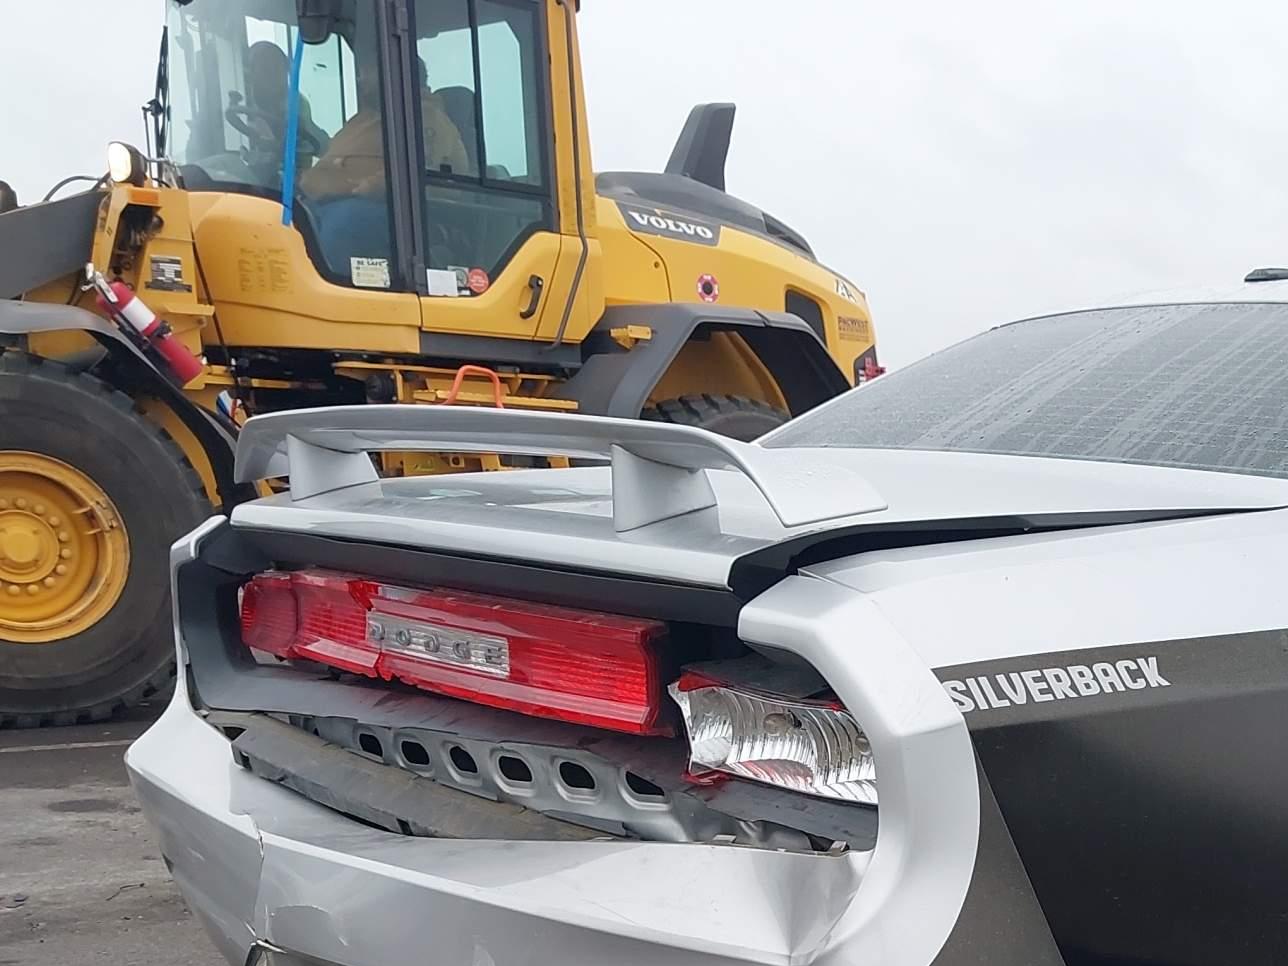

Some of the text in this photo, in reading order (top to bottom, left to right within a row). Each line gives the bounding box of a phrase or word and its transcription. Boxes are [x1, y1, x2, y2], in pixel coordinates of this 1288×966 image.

[627, 211, 714, 239] VOLVO
[371, 621, 504, 665] DODGE
[941, 656, 1172, 713] SILVERBACK
